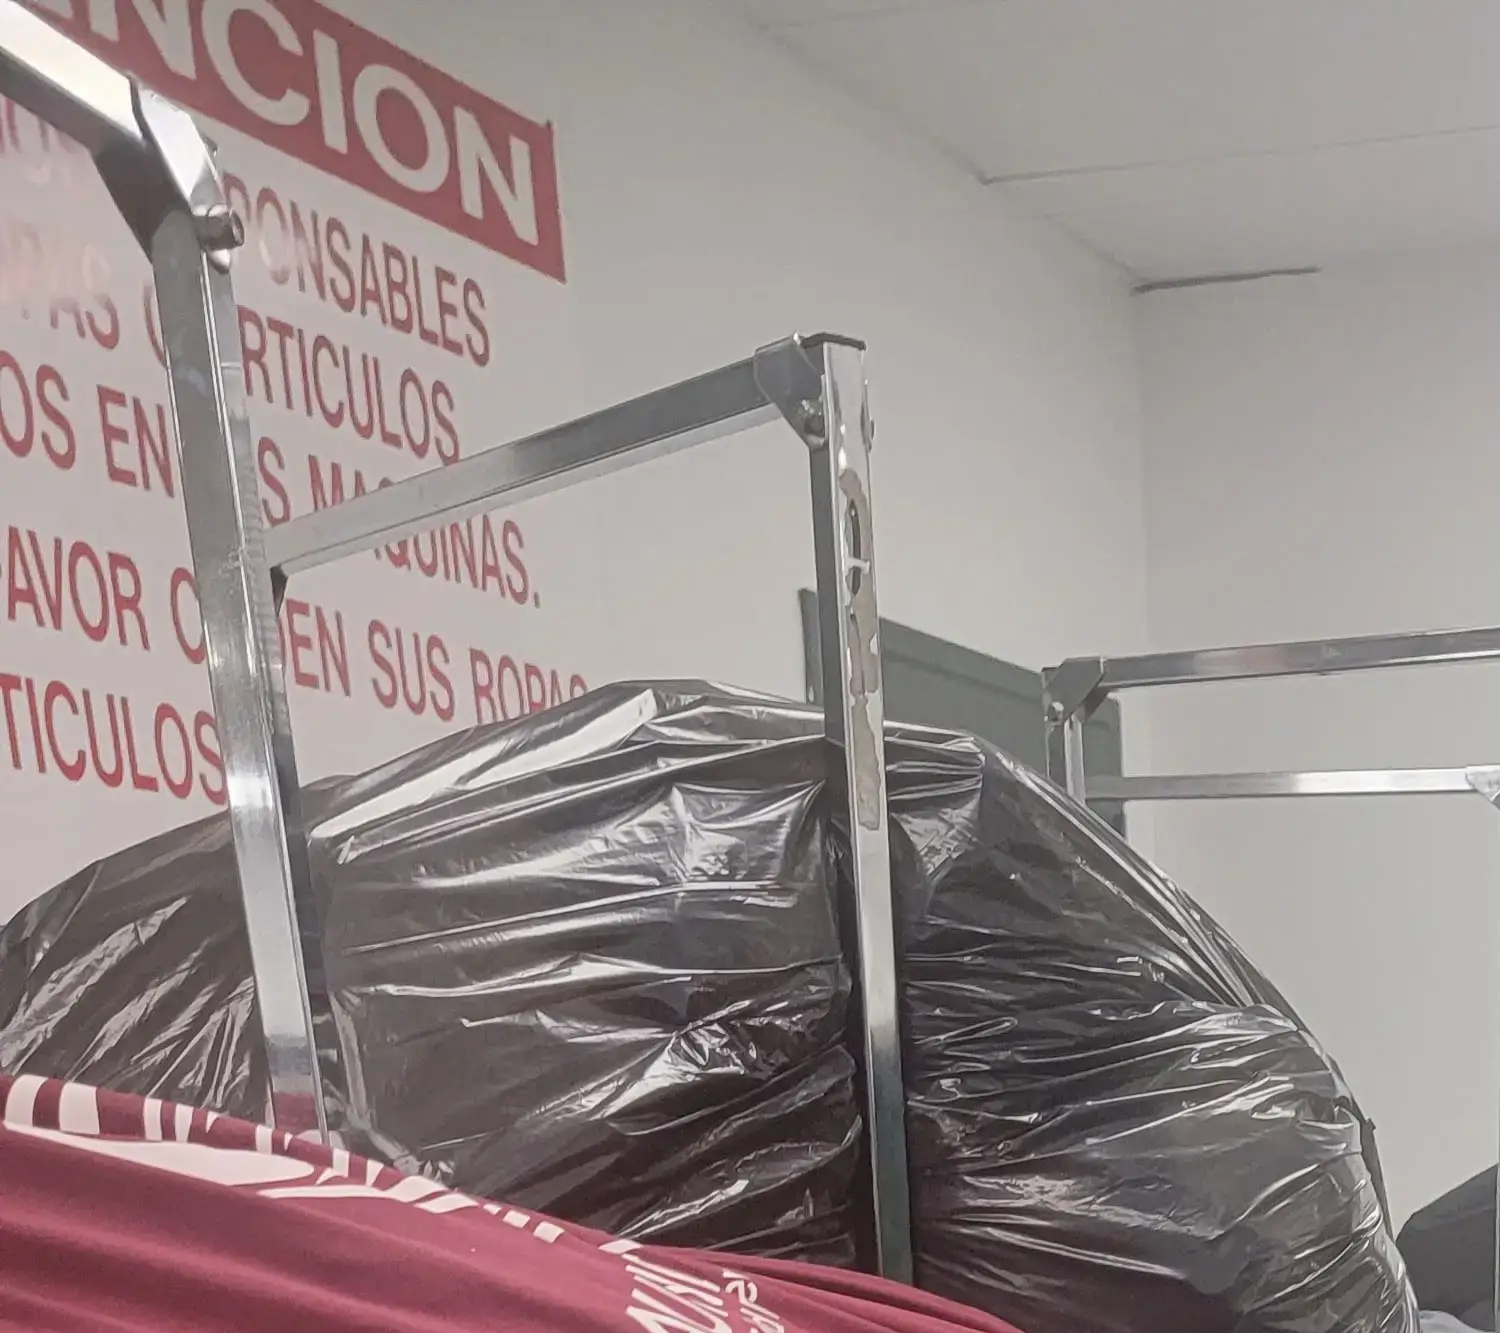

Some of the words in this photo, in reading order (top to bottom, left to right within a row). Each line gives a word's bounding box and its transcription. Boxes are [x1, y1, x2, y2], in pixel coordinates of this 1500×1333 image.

[45, 0, 539, 246] NCION
[97, 384, 175, 498] EN
[237, 304, 460, 466] RTICULOS
[0, 525, 151, 652] AVOR
[368, 619, 454, 722] SUS
